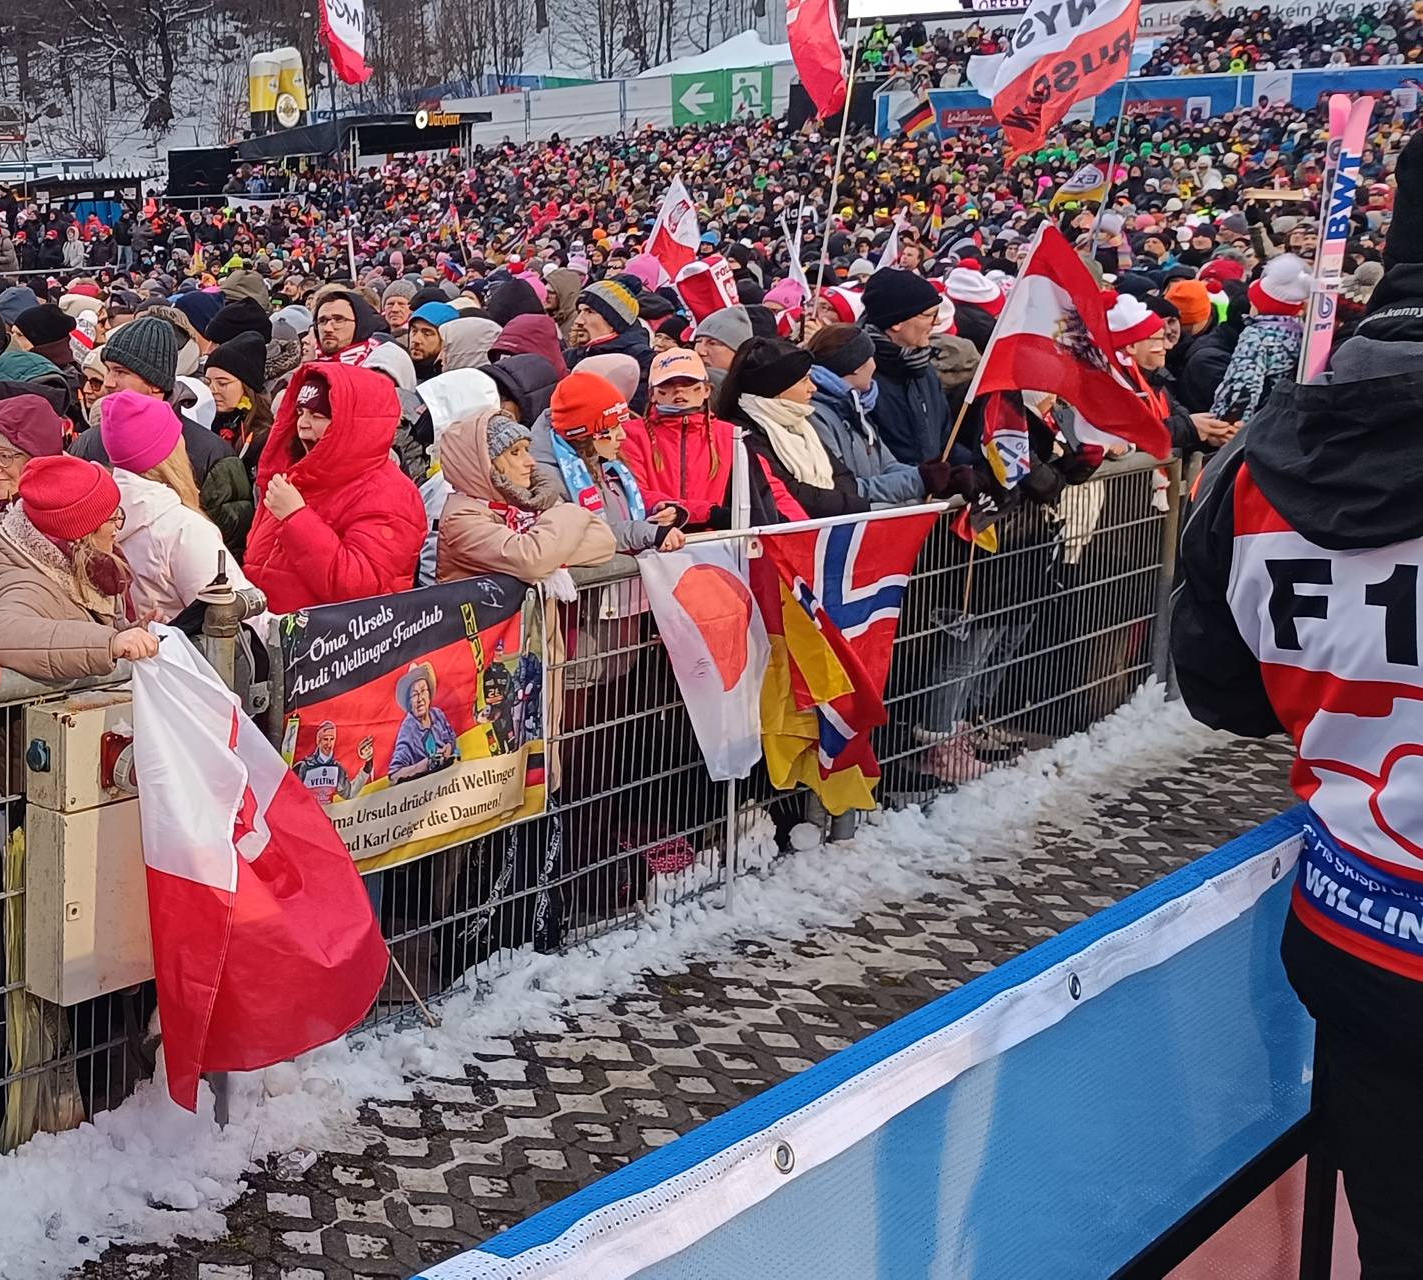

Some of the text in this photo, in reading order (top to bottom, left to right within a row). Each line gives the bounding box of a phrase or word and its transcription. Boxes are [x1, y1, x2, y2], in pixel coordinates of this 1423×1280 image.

[1326, 151, 1362, 241] BWT
[288, 665, 331, 702] Andi
[331, 637, 393, 681] Wellinger
[392, 604, 444, 647] Fanclub
[348, 604, 395, 639] Ursels
[329, 765, 516, 831] ma Ursula drückt Andi Wellinger
[363, 828, 390, 850] Karl
[392, 817, 425, 841] Geiger
[427, 810, 449, 829] die
[451, 792, 503, 822] Daumen!
